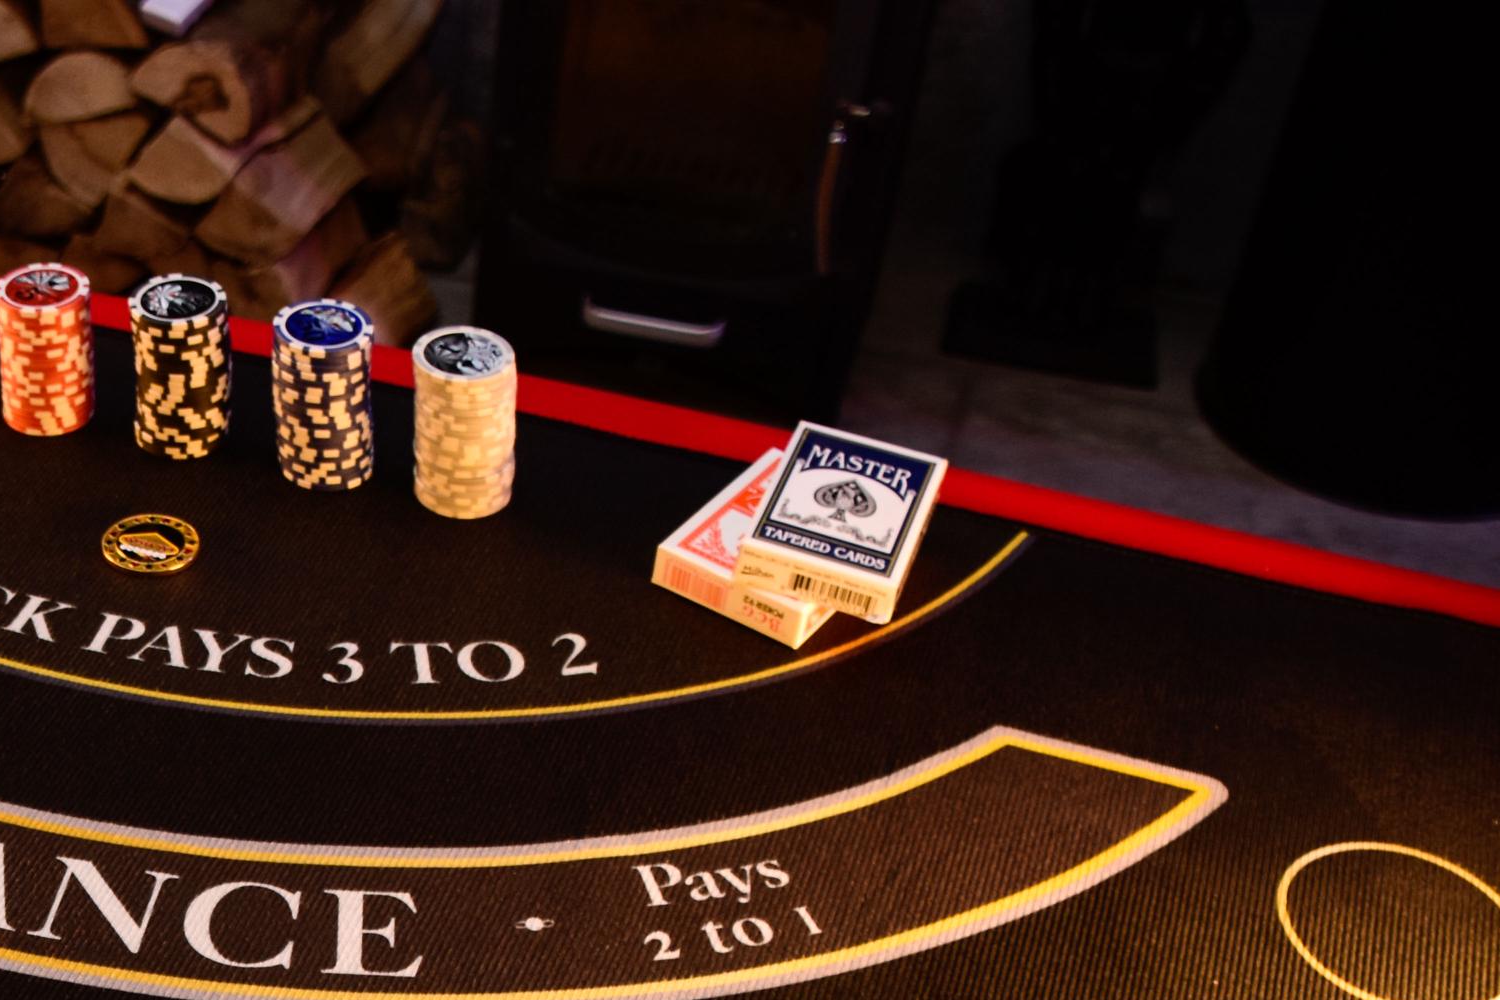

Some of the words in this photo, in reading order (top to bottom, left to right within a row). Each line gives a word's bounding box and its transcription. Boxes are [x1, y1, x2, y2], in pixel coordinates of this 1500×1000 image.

[799, 444, 916, 501] MASTER
[764, 526, 831, 554] TAPERED
[833, 547, 886, 571] CARDS
[81, 612, 296, 679] PAYS
[321, 641, 364, 684] 3
[389, 640, 525, 685] TO
[551, 632, 598, 677] 2
[632, 858, 790, 907] Pays
[643, 930, 681, 961] 2
[701, 916, 775, 954] to
[793, 905, 823, 936] 1
